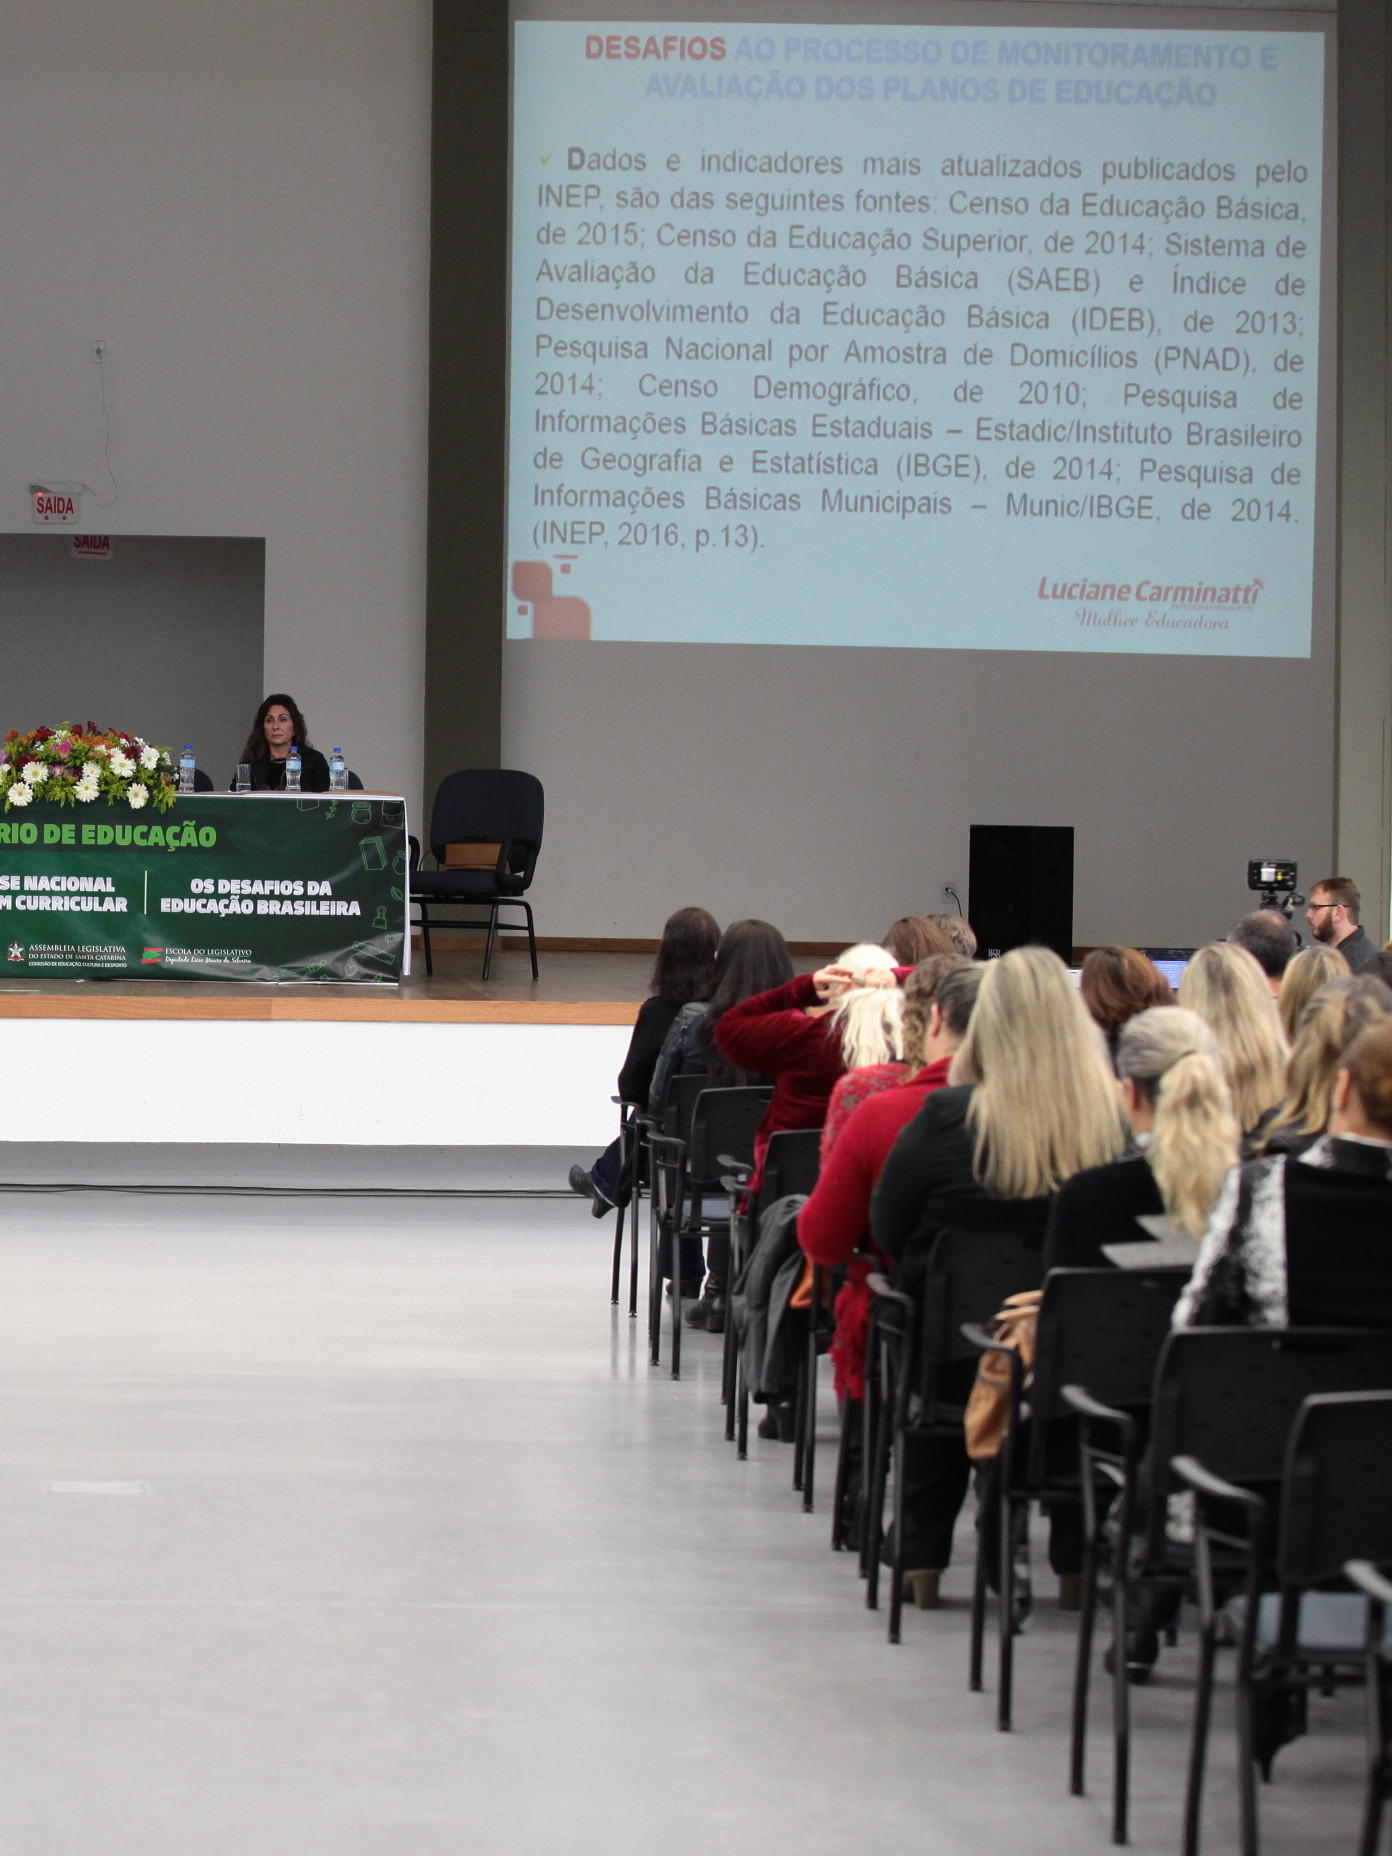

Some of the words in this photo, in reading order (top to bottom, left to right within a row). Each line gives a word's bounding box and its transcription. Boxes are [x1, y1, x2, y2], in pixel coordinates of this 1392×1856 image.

[585, 35, 727, 60] DESAFIOS
[734, 37, 776, 61] AO
[784, 38, 942, 64] PROCESSO
[951, 40, 989, 65] DE
[998, 41, 1251, 69] MONITORAMENTO
[1260, 47, 1277, 70] E
[644, 70, 806, 105] AVALIAÇÃO
[814, 75, 875, 100] DOS
[883, 77, 999, 102] PLANOS
[1008, 79, 1047, 102] DE
[1055, 76, 1217, 109] EDUCAÇÃO
[568, 147, 647, 171] Dados
[666, 154, 680, 172] e
[701, 150, 843, 174] indicadores
[863, 157, 921, 176] mais
[941, 154, 1082, 179] atualizados
[1102, 157, 1235, 185] publicados
[1256, 160, 1308, 188] pelo
[537, 297, 749, 324] Desenvolvimento
[770, 301, 800, 325] da
[823, 301, 945, 333] Educação
[968, 304, 1049, 329] Básica
[1072, 306, 1161, 337] (IDEB),
[1184, 310, 1214, 333] de
[1235, 310, 1303, 336] 2013;
[535, 372, 602, 397] 2014;
[639, 373, 718, 398] Censo
[754, 375, 917, 407] Demográfico,
[953, 380, 983, 403] de
[1019, 380, 1086, 407] 2010;
[1124, 383, 1237, 414] Pesquisa
[1273, 387, 1303, 410] de
[536, 409, 686, 440] Informações
[701, 411, 797, 437] Básicas
[812, 414, 933, 439] Estaduais
[976, 417, 1172, 445] Estadic/Instituto
[1187, 422, 1302, 448] Brasileiro
[534, 483, 685, 515] Informações
[706, 486, 801, 511] Básicas
[822, 488, 952, 520] Municipais
[1007, 492, 1160, 521] Munic/IBGE,
[1181, 498, 1211, 520] de
[1231, 498, 1298, 523] 2014.
[533, 521, 608, 548] (INEP,
[618, 522, 685, 548] 2016,
[696, 524, 764, 553] p.13).
[1038, 576, 1131, 601] Luciane
[1135, 578, 1264, 604] Carminatti
[1075, 608, 1138, 627] Mulher
[1144, 609, 1230, 629] Educadora
[44, 824, 75, 844] DE
[82, 820, 217, 851] EDUCAÇÃO
[24, 876, 115, 892] NACIONAL
[190, 878, 214, 894] OS
[218, 879, 304, 896] DESAFIOS
[307, 881, 332, 896] DA
[15, 895, 128, 912] CURRICULAR
[160, 895, 253, 917] EDUCAÇÃO
[257, 900, 361, 916] BRASILEIRA
[29, 944, 75, 952] ASSEMBLEIA
[78, 945, 126, 953] LEGISLATIVA
